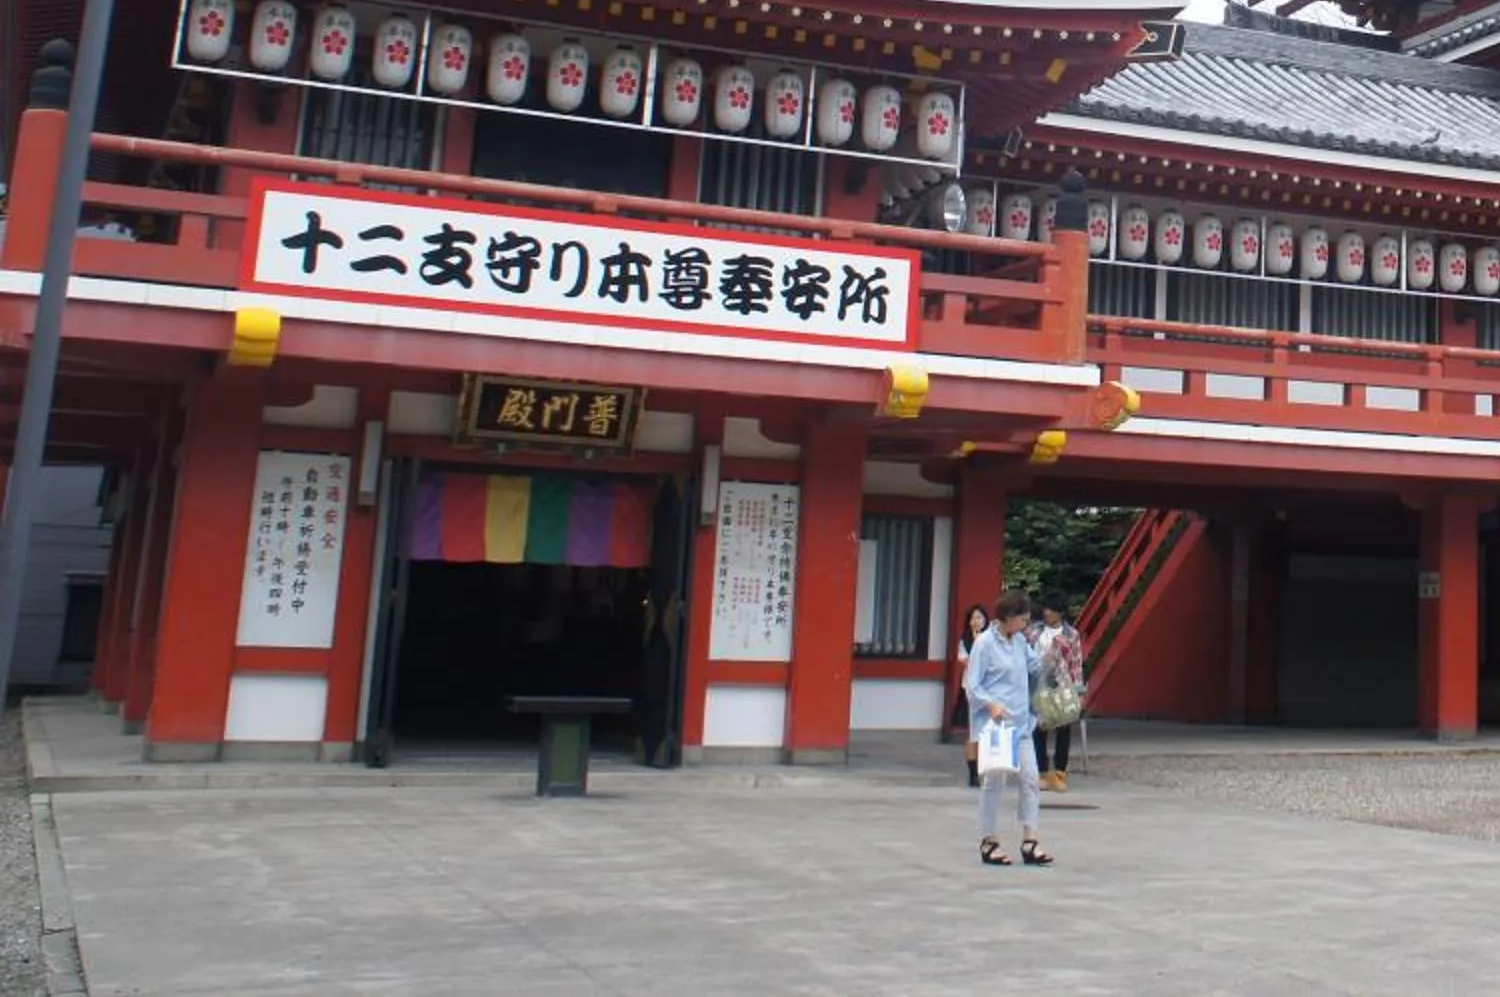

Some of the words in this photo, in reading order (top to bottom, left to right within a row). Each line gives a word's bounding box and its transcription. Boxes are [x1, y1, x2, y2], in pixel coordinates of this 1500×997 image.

[281, 210, 891, 324] 十二支守り本尊奉安所
[320, 463, 343, 550] 交通安全
